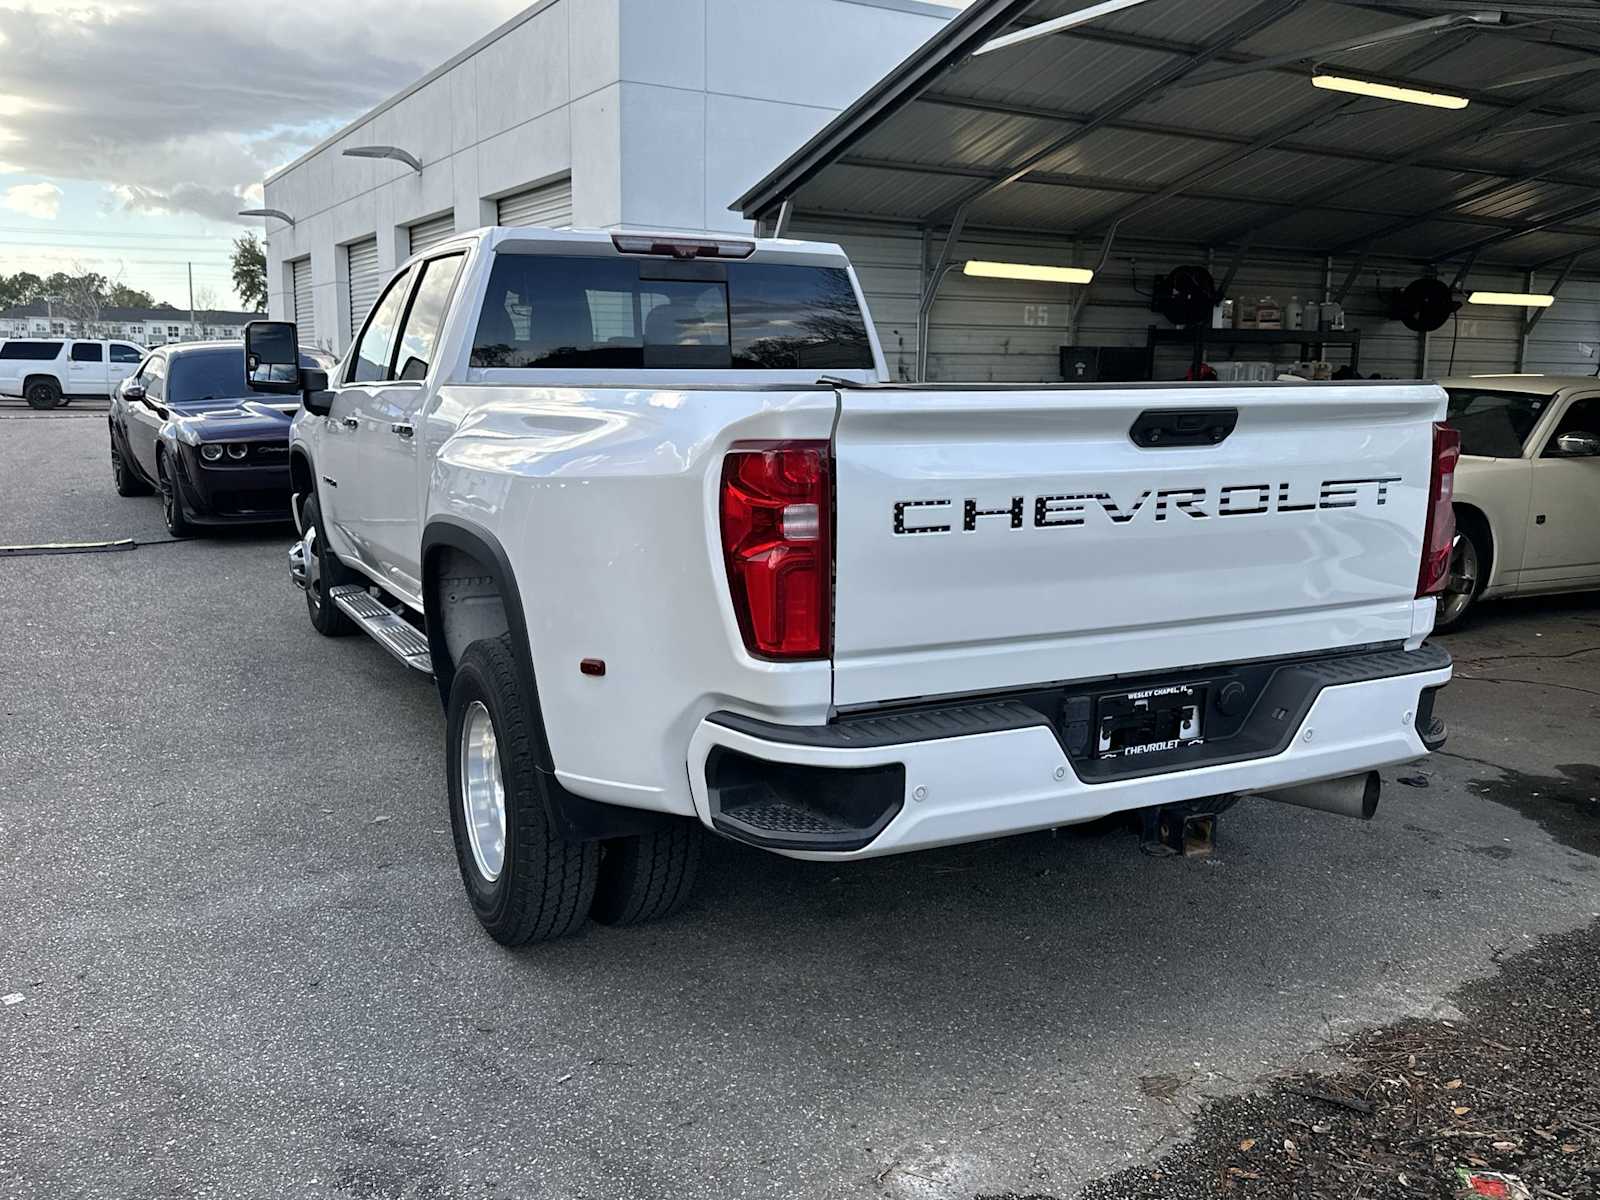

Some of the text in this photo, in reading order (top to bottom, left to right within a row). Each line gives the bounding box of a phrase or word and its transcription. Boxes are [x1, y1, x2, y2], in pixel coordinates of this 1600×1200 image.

[1024, 305, 1048, 326] C5
[894, 476, 1402, 534] CHEVROLET
[1128, 690, 1153, 700] WESLEY
[1180, 684, 1188, 692] FL
[1124, 739, 1180, 756] CHEVROLET
